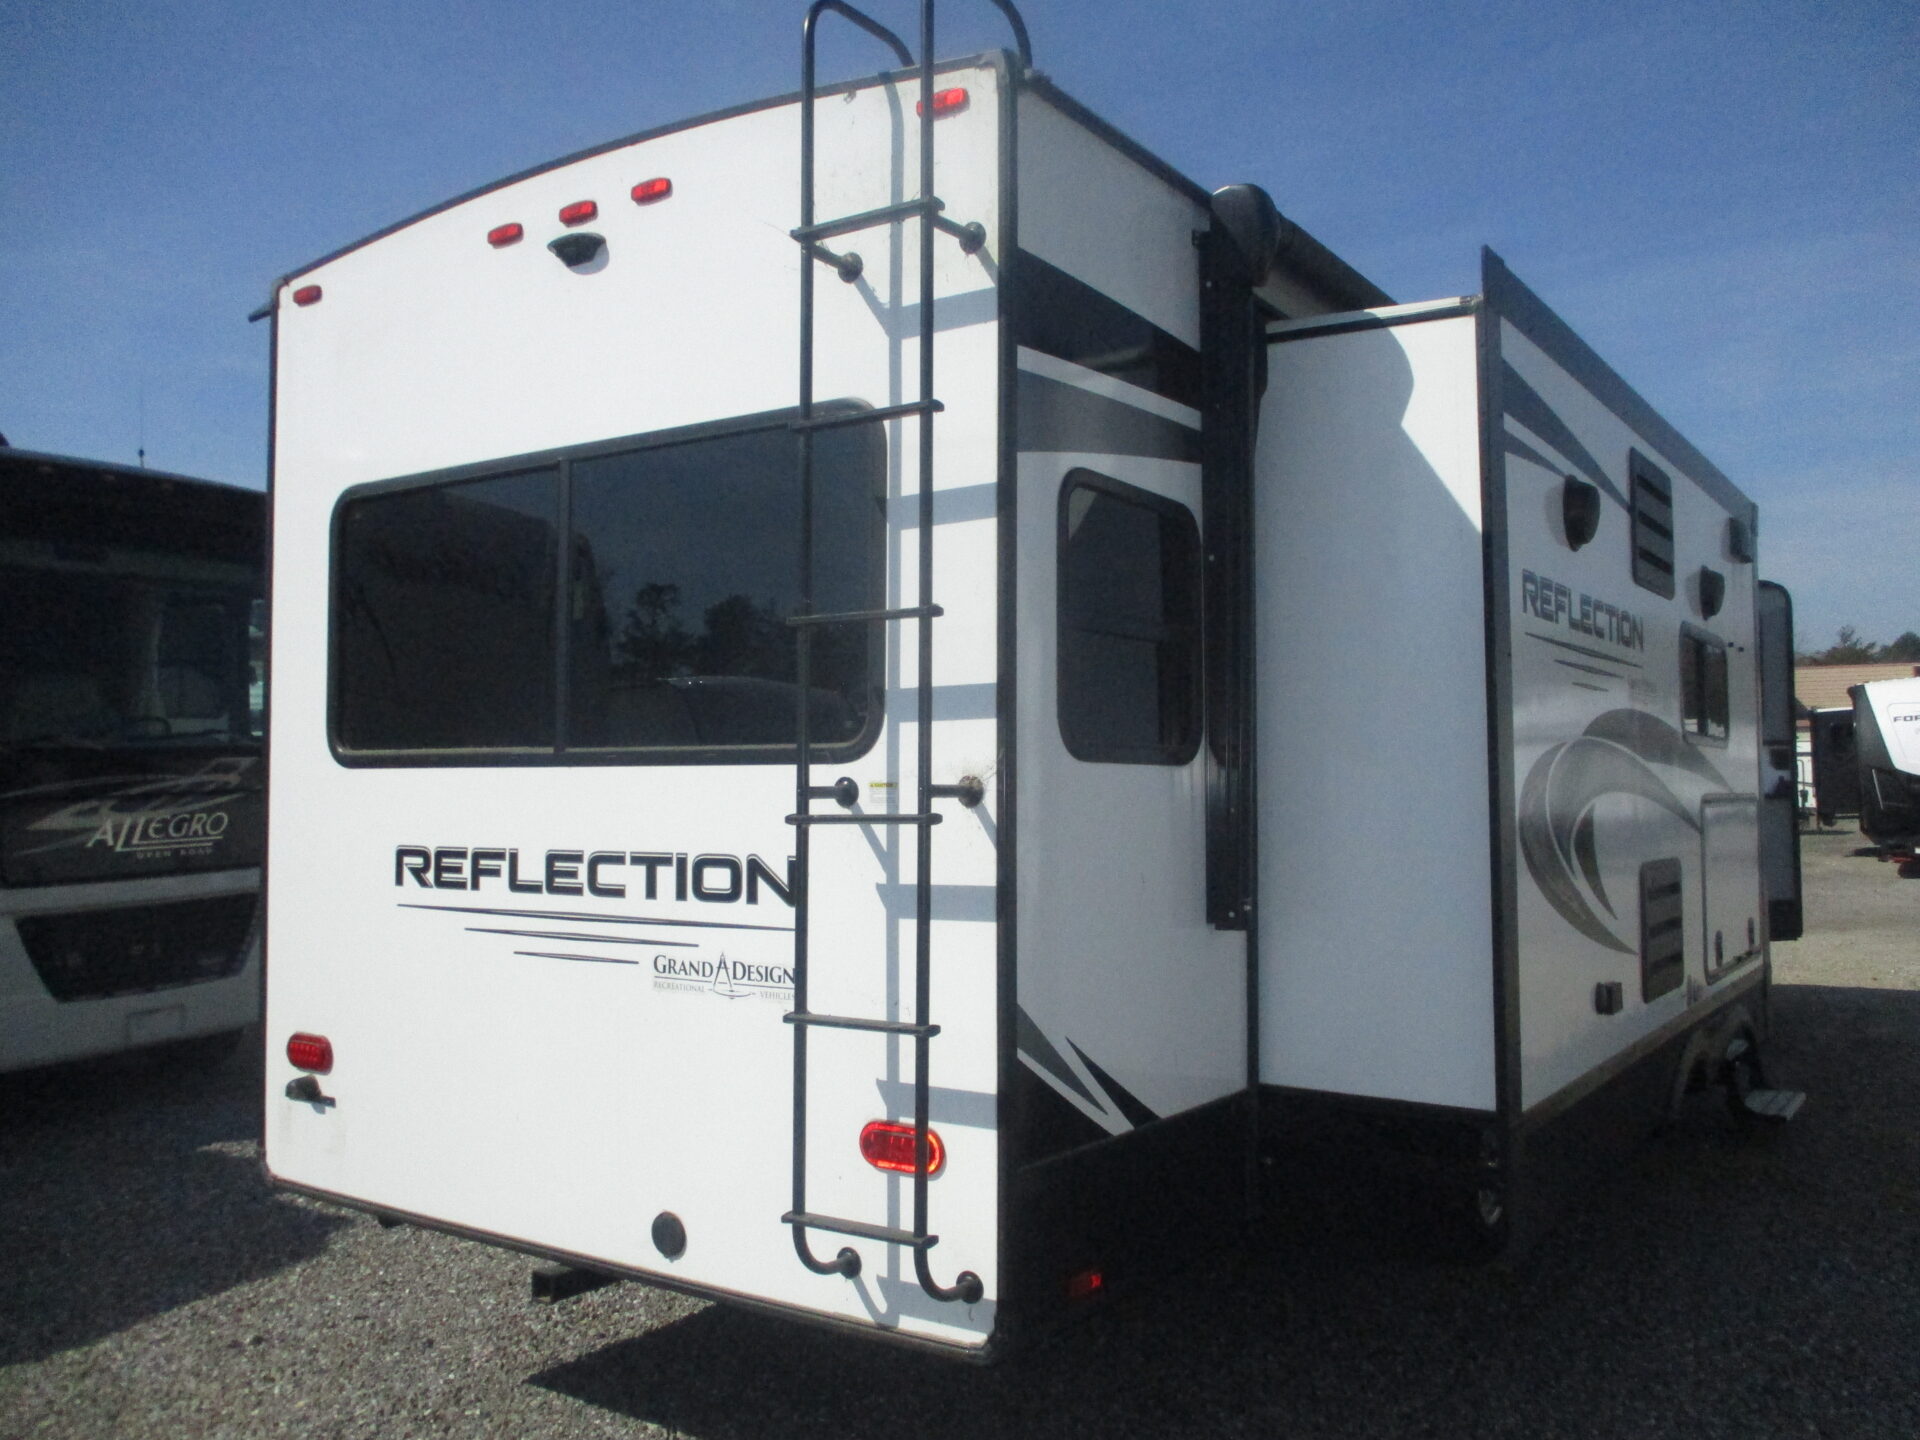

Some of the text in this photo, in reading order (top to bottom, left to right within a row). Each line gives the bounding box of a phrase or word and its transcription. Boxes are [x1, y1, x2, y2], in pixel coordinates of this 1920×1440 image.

[1522, 568, 1644, 652] REFLECTION
[85, 811, 229, 852] ALLEGRO
[395, 845, 797, 907] REFLECTION
[653, 954, 796, 985] GRAND DESIGN
[653, 980, 705, 993] RECREATIONAL
